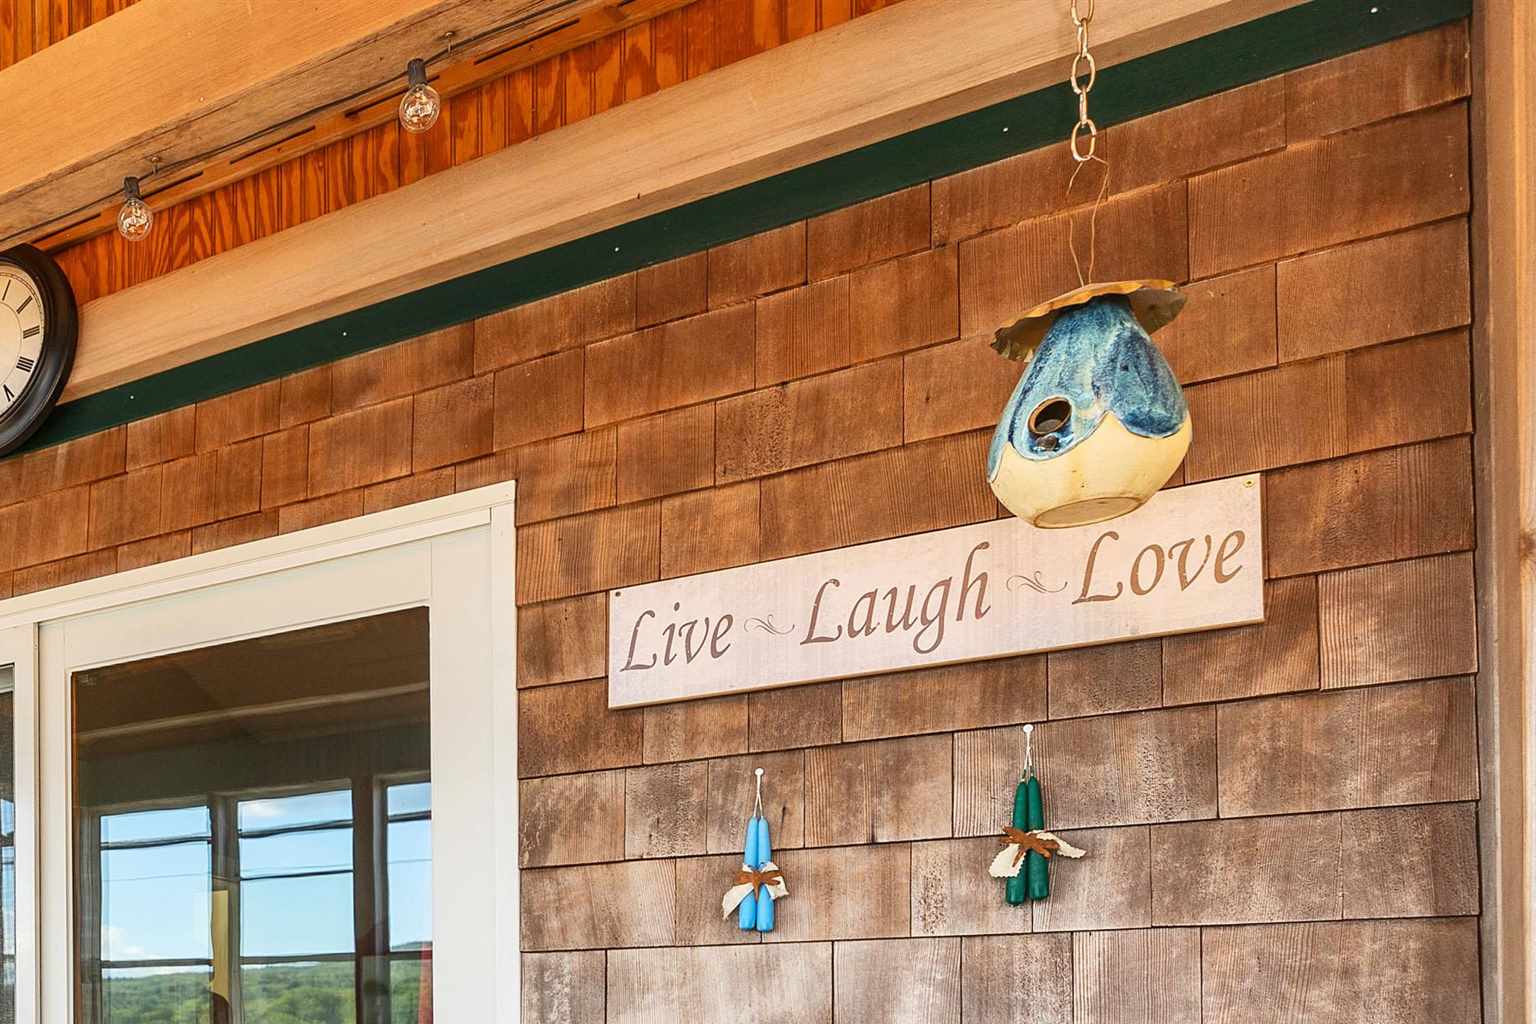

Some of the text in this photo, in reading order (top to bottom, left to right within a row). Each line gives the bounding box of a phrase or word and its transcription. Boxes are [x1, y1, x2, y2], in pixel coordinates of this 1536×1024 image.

[620, 530, 1247, 673] Live Laugh Love
